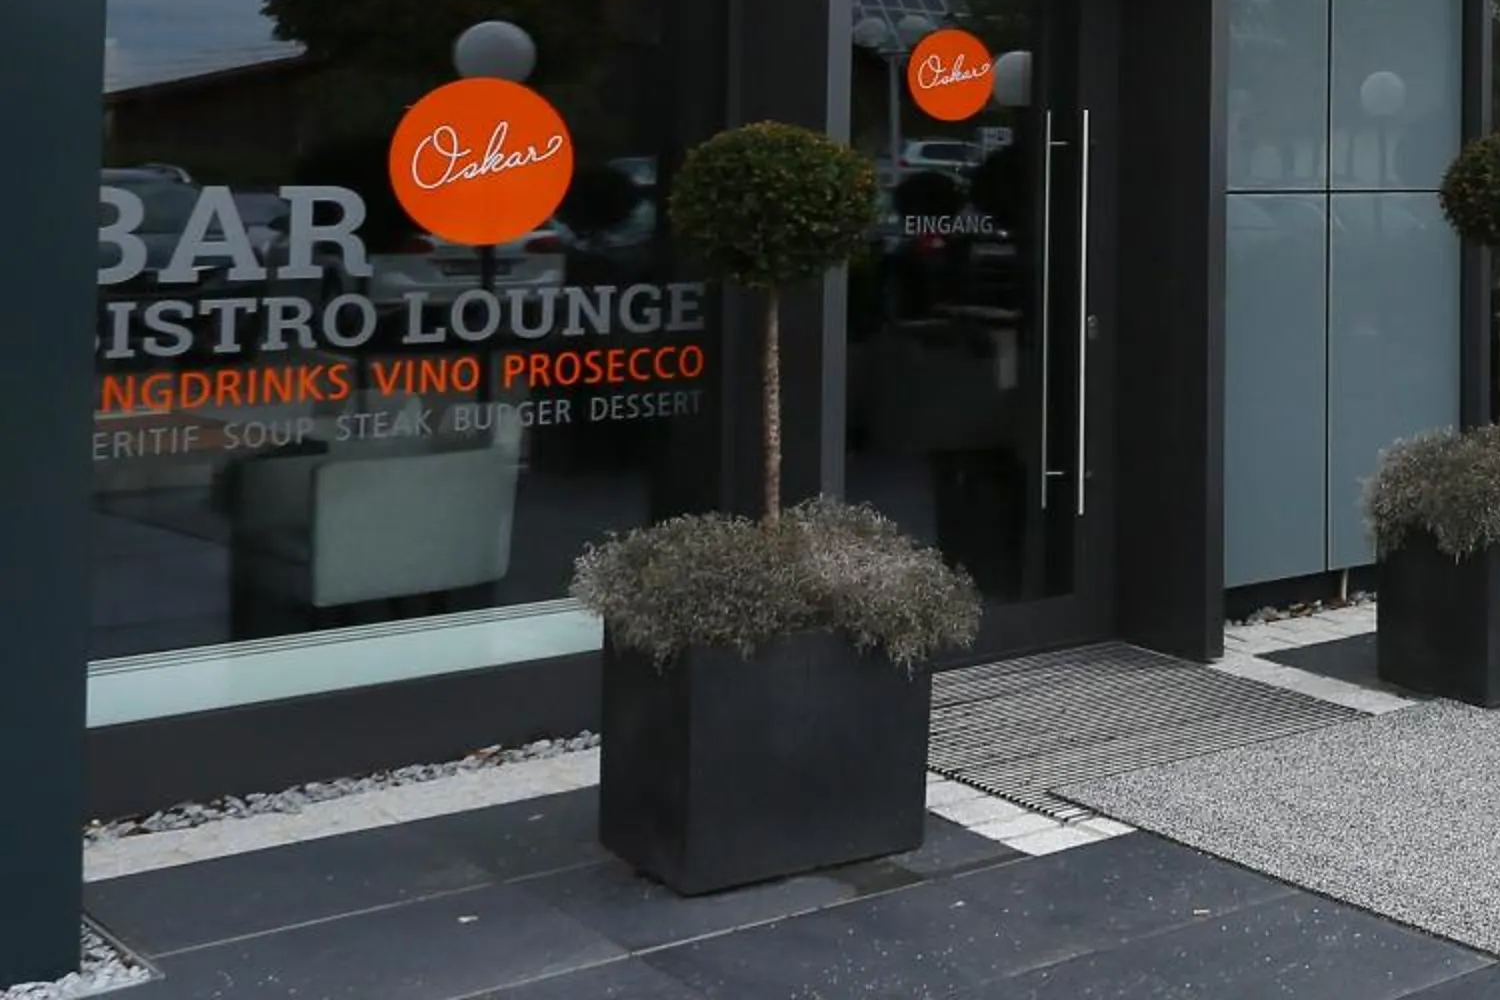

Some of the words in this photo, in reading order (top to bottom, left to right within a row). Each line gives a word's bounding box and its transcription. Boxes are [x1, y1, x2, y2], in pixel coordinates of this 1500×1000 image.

[919, 53, 993, 90] Oskar
[411, 120, 564, 190] Oskar
[96, 185, 374, 285] BAR
[904, 215, 994, 235] EINGANG
[96, 293, 377, 359] ISTRO
[402, 283, 705, 344] LOUNGE
[101, 363, 350, 414] NGDRINKS
[372, 355, 481, 397] VINO
[504, 345, 705, 389] PROSECCO
[223, 416, 316, 450] SOUP
[336, 408, 433, 442] STEAK
[591, 389, 704, 422] DESSERT
